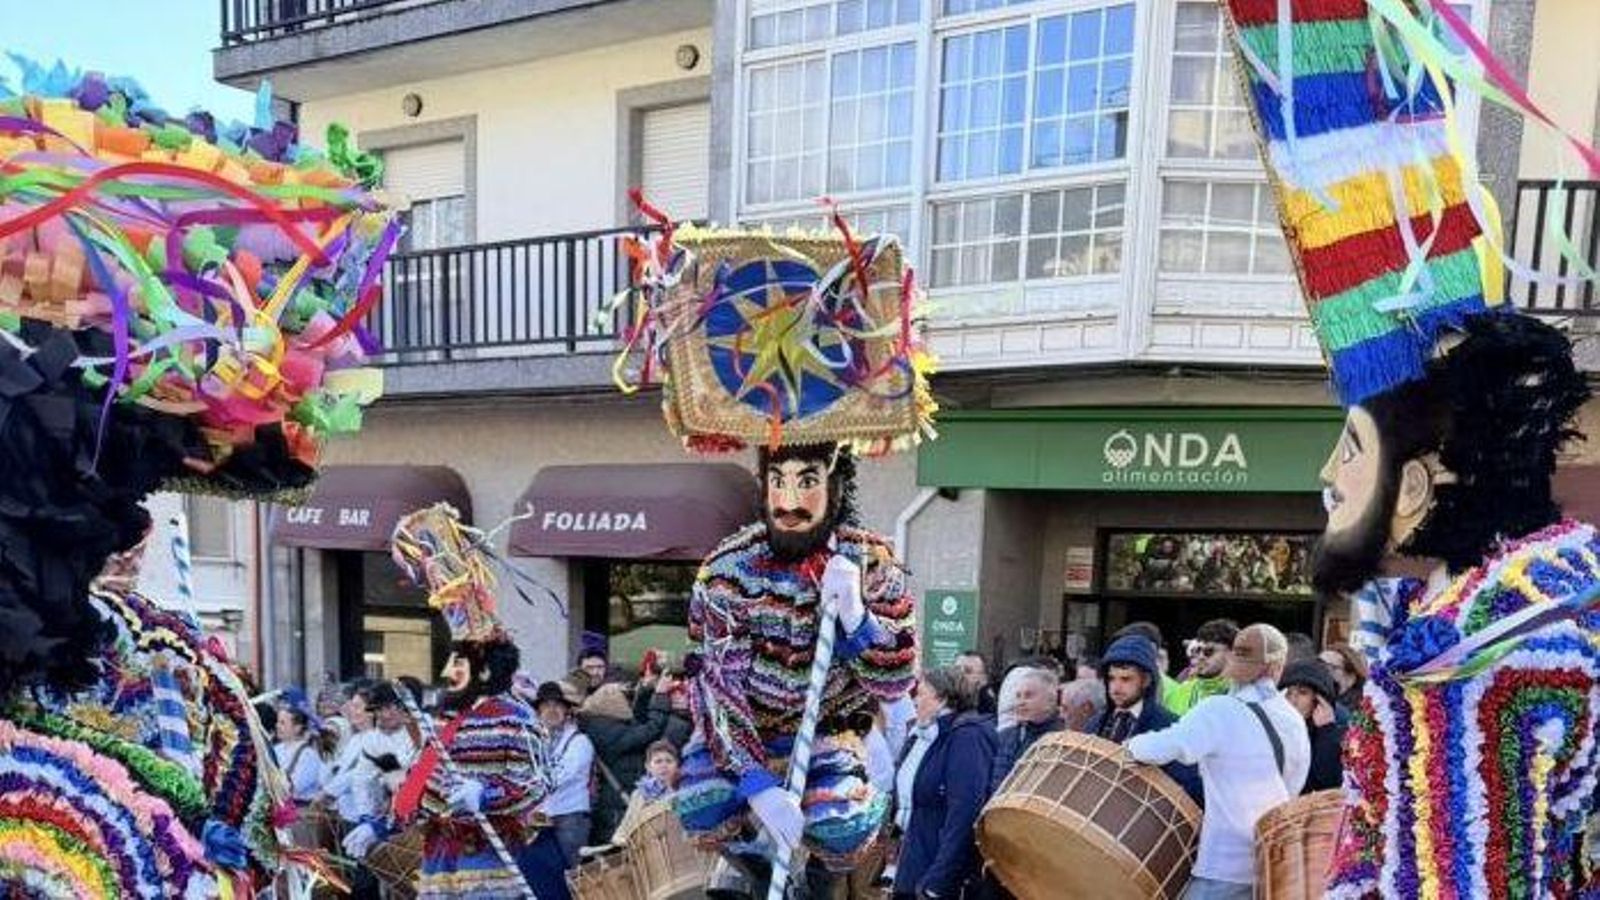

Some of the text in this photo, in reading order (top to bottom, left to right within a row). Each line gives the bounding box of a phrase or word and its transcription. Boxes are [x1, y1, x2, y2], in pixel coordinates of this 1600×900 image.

[1103, 429, 1247, 468] ONDA
[1102, 469, 1248, 484] alimentación
[339, 507, 370, 526] BAR
[542, 511, 647, 531] FOLIADA
